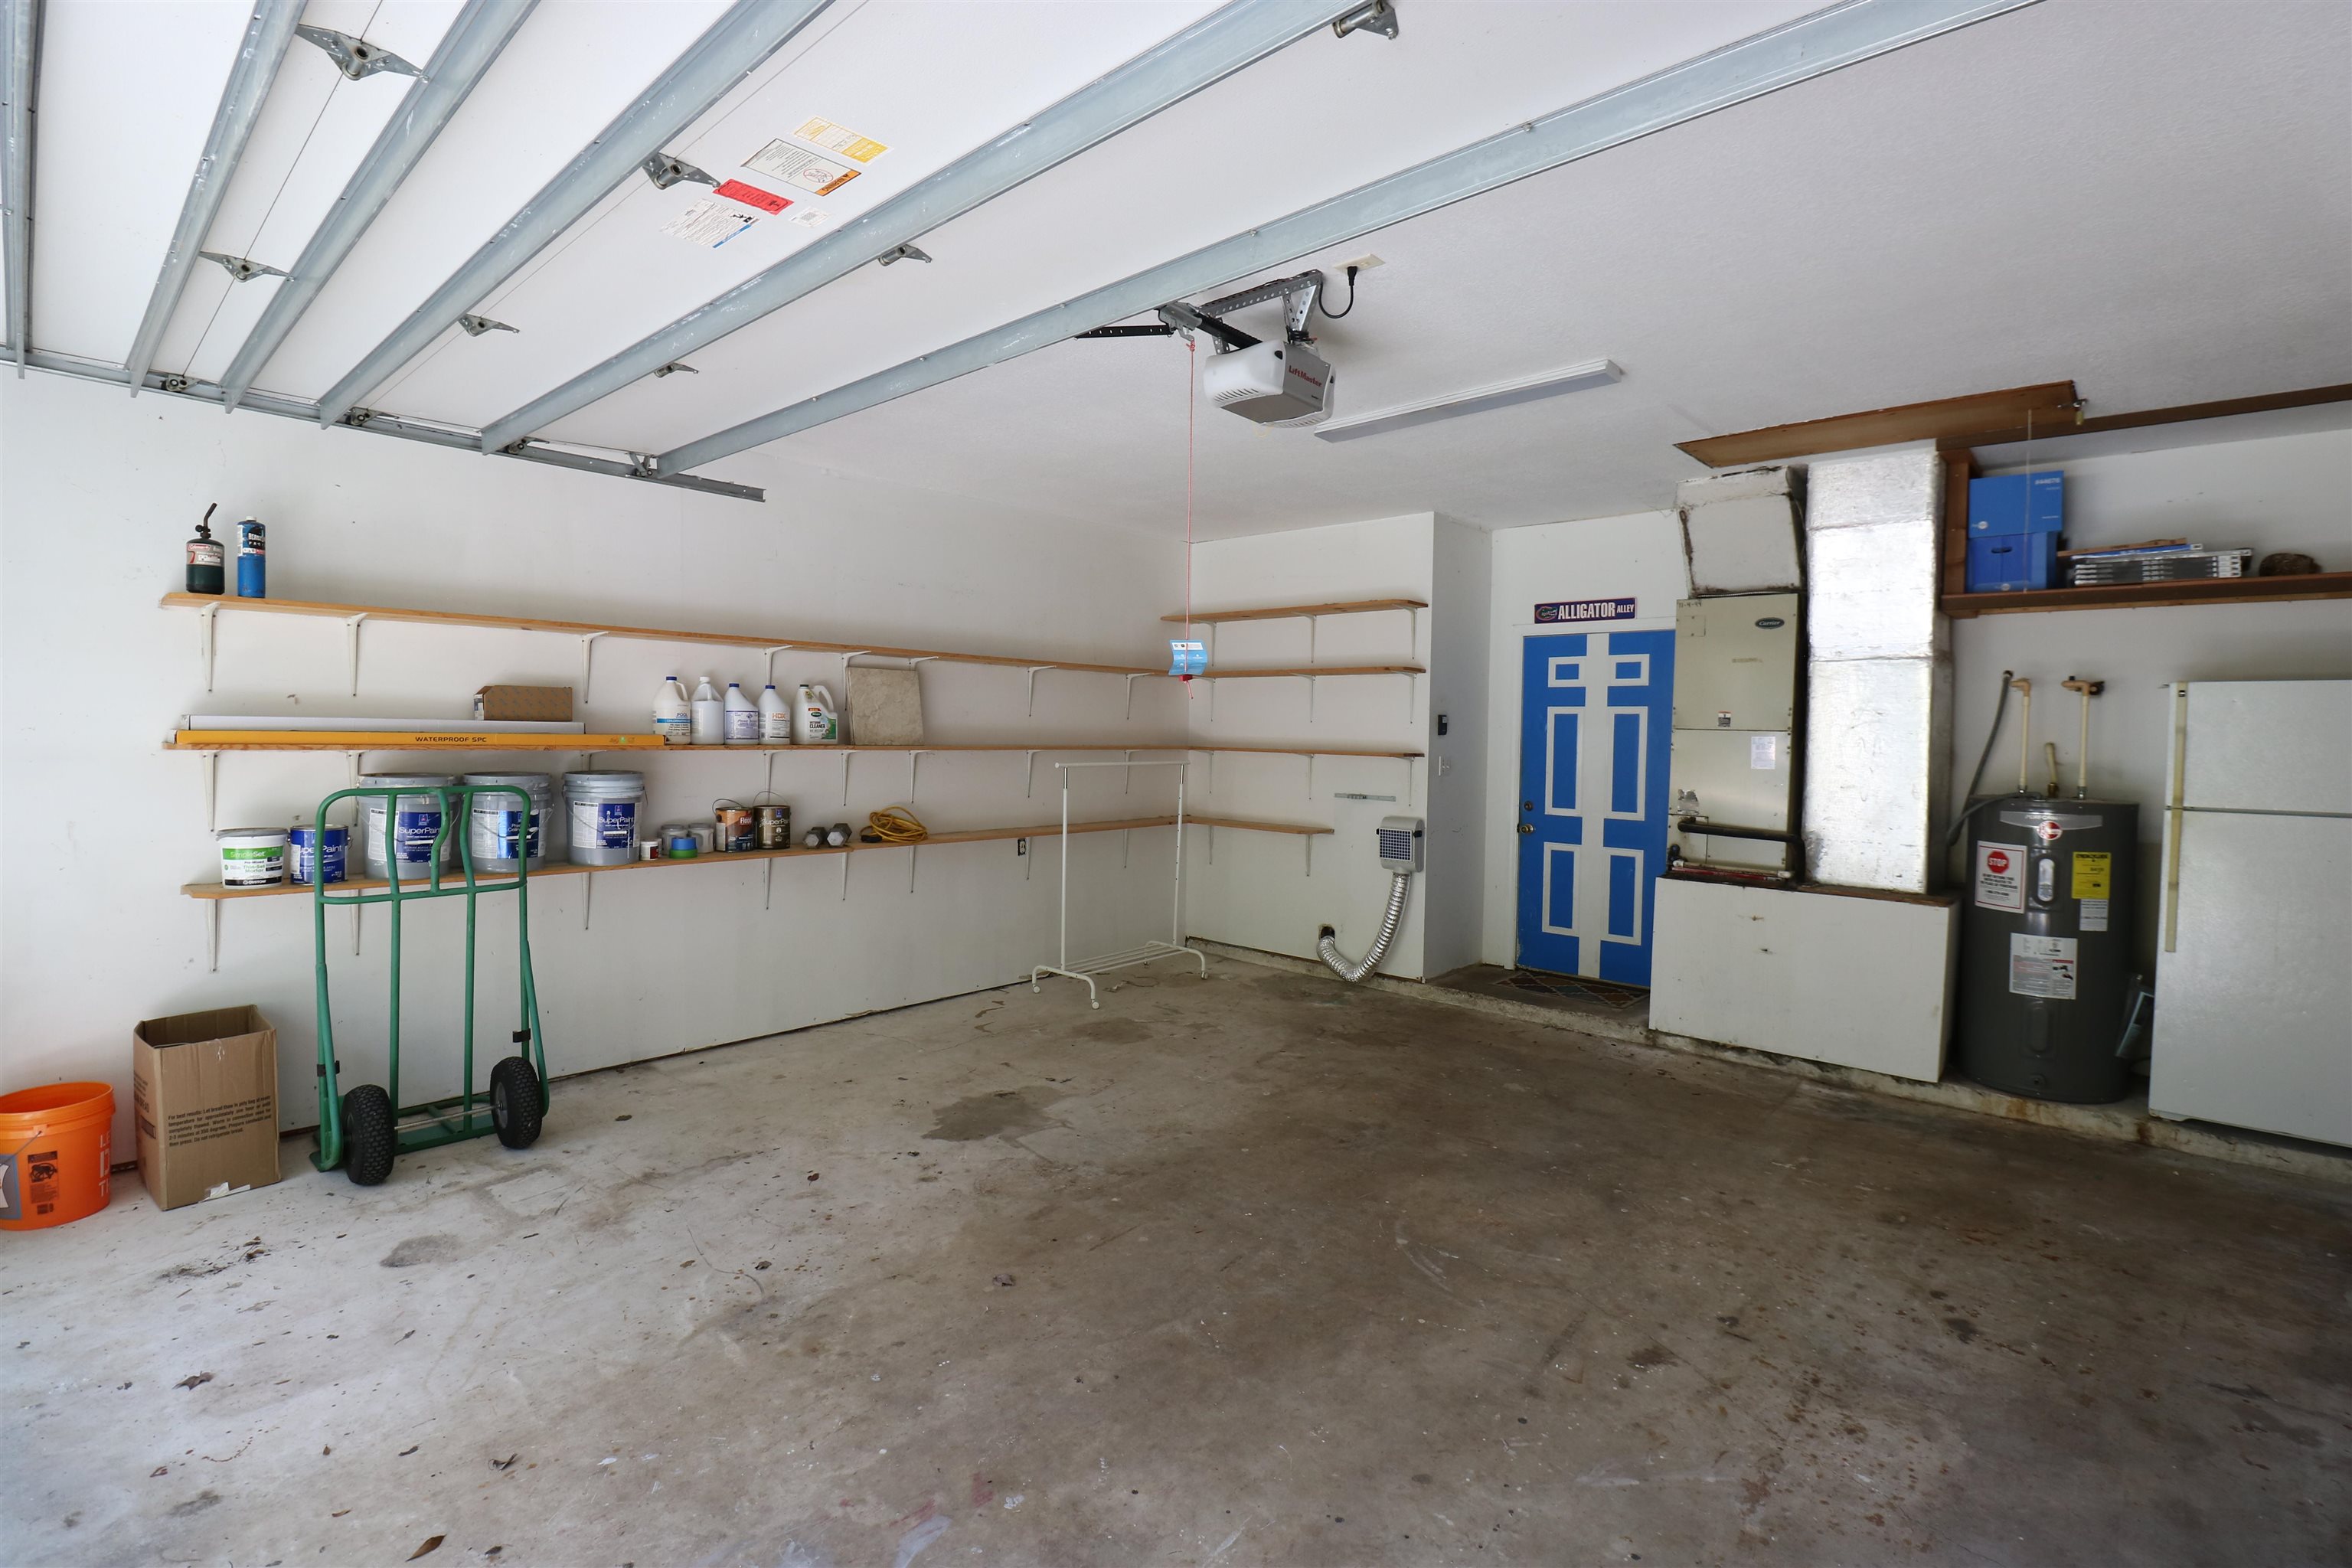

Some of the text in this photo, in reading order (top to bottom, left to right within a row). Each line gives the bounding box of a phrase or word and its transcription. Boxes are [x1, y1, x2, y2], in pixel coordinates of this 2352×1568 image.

[1289, 364, 1322, 387] LiftMaster
[1558, 602, 1635, 620] ALLIGATOR ALLEY
[1988, 858, 2007, 867] STOP
